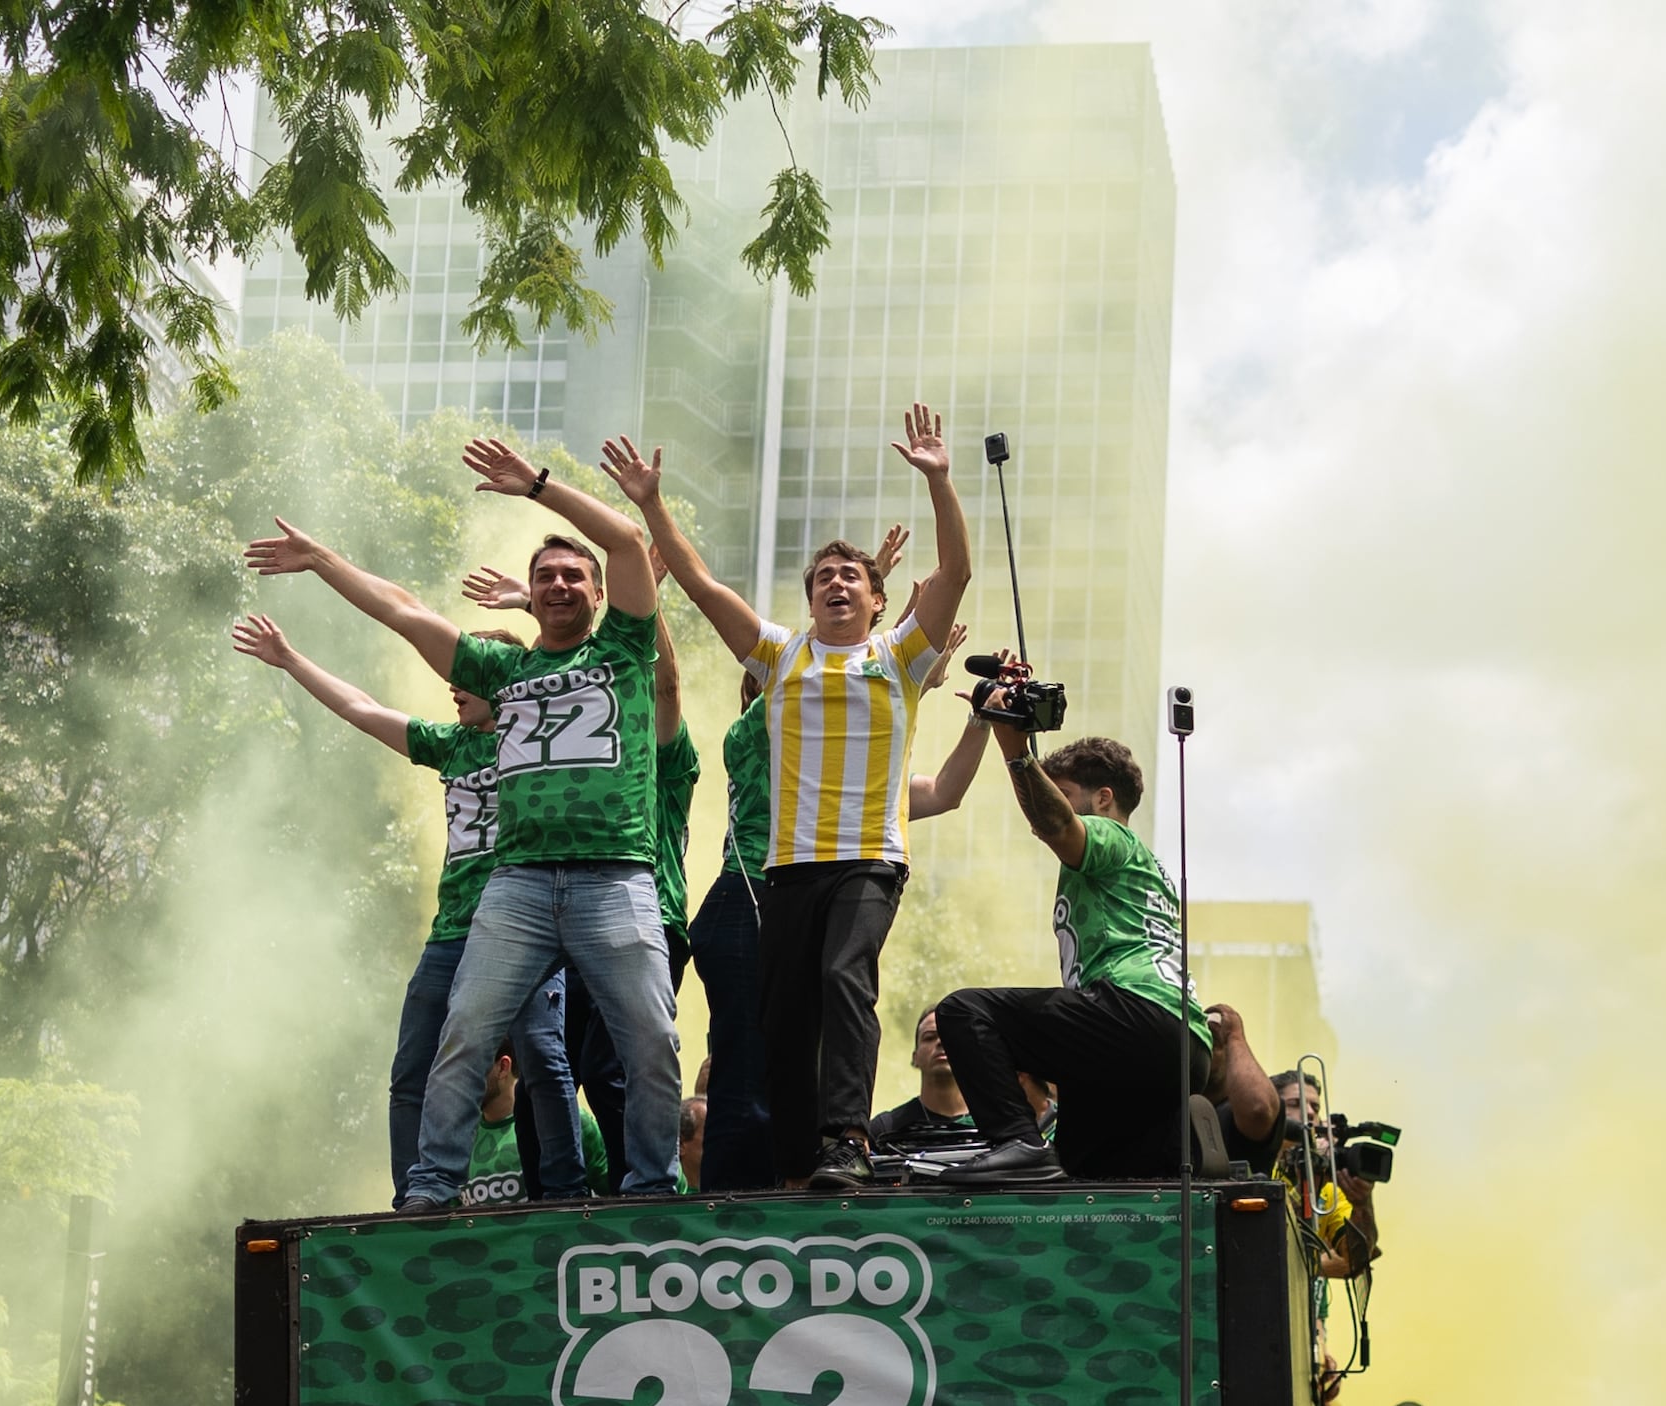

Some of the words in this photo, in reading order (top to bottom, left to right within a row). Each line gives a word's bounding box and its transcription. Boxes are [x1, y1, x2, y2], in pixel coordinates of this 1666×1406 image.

[568, 668, 606, 689] DO
[496, 685, 613, 774] 22
[926, 1216, 950, 1226] CNPJ
[1036, 1214, 1060, 1224] CNPJ
[1145, 1213, 1177, 1223] Tiragem
[579, 1258, 794, 1315] BLOCO
[810, 1256, 910, 1307] DO
